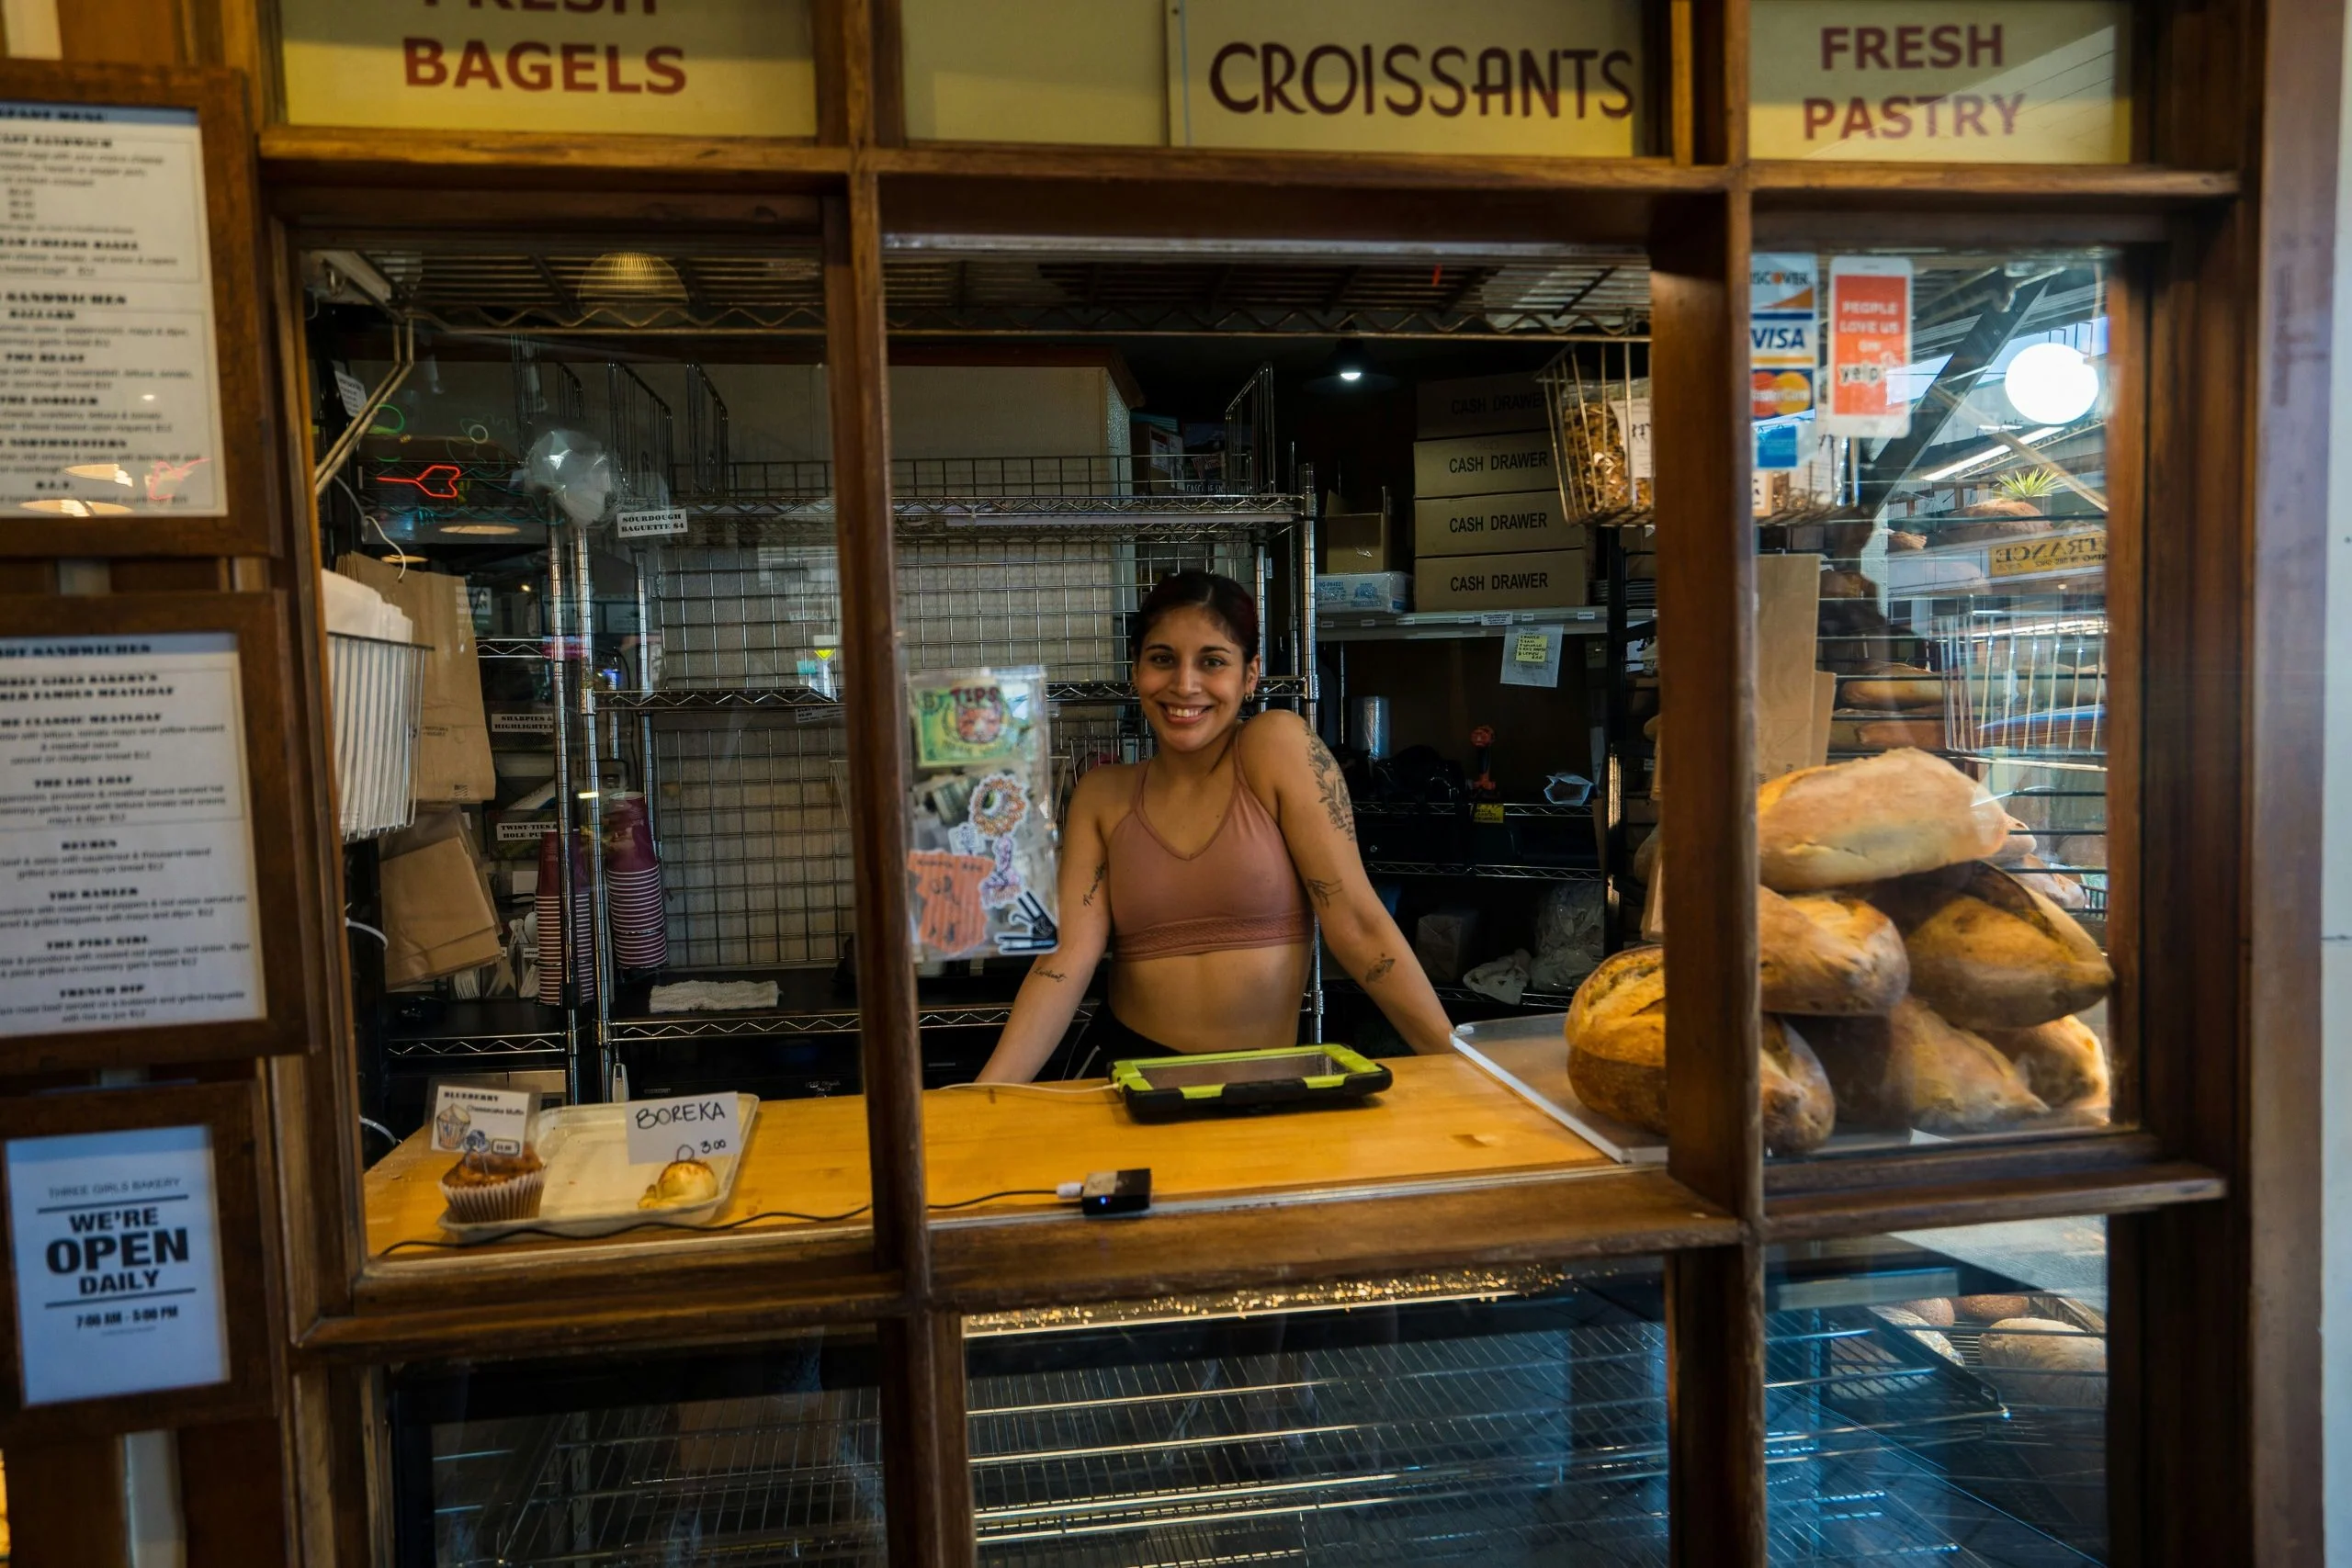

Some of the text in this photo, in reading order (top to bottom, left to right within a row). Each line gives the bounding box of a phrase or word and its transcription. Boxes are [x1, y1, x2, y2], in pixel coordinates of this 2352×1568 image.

[1820, 23, 2005, 71] FRESH
[402, 37, 687, 96] BAGELS
[1209, 41, 1635, 119] CROISSANTS
[1802, 93, 2028, 141] PASTRY
[1750, 271, 1809, 286] SCOVER
[1842, 300, 1899, 315] PEOPLE
[1750, 327, 1807, 350] VISA
[1839, 321, 1900, 334] LOVE US
[1451, 398, 1487, 415] CASH
[1449, 451, 1549, 474] CASH DRAWER
[621, 524, 671, 533] BAGUETTE
[622, 513, 682, 523] SOURDOUGH
[1449, 512, 1548, 534] CASH DRAWER
[1450, 572, 1549, 592] CASH DRAWER
[950, 686, 1001, 703] TIPS
[444, 1090, 500, 1102] BLUEBERRY
[635, 1101, 726, 1130] BOREKA
[69, 1207, 159, 1234] WE'RE
[46, 1226, 189, 1275] OPEN
[79, 1269, 160, 1296] DAILY
